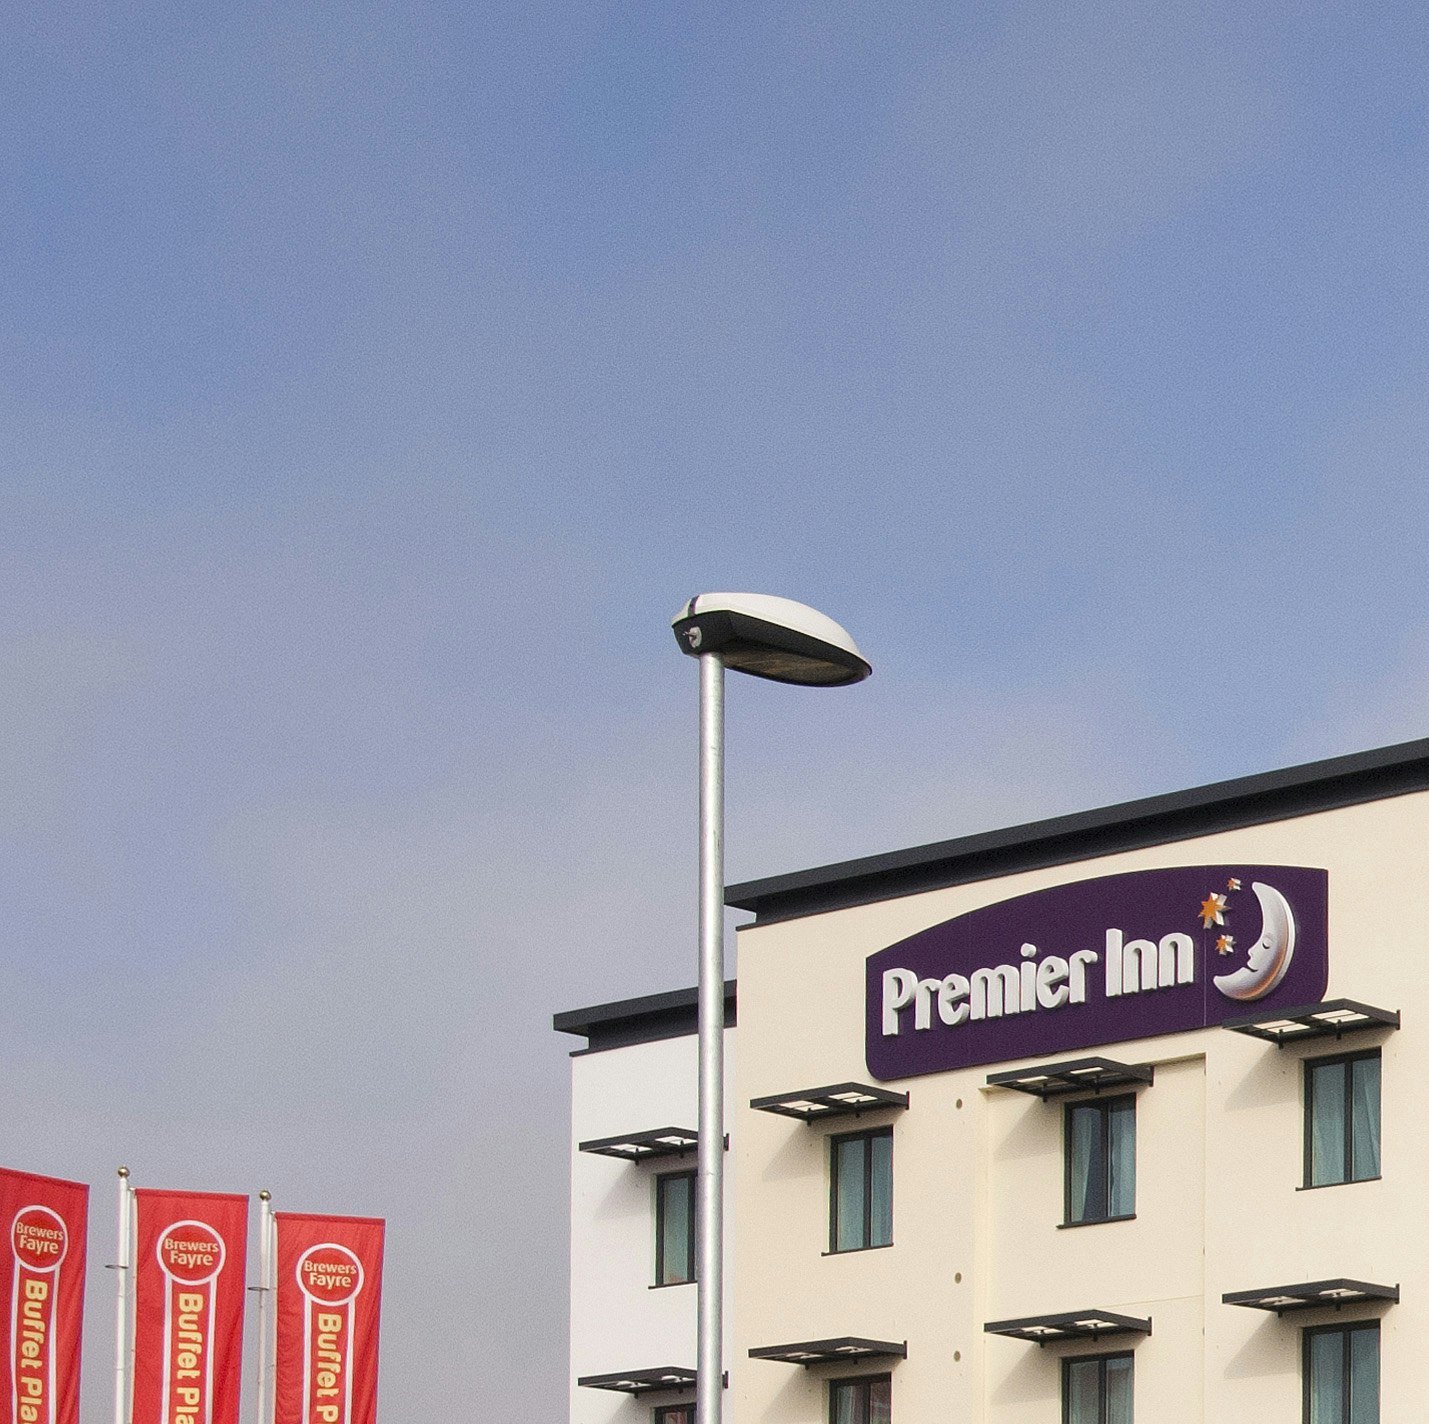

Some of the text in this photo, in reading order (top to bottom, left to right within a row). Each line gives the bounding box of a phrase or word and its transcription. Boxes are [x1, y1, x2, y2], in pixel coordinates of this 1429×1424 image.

[882, 928, 1195, 1036] Premier Inn
[15, 1222, 64, 1243] Brewers
[19, 1236, 59, 1255] Fayre
[164, 1237, 219, 1255] Brewers
[169, 1250, 214, 1267] Fayre
[304, 1260, 357, 1276] Brewers
[308, 1271, 352, 1290] Fayre
[20, 1279, 48, 1369] Buffet
[176, 1293, 203, 1380] Buffet
[316, 1313, 343, 1398] Buffet
